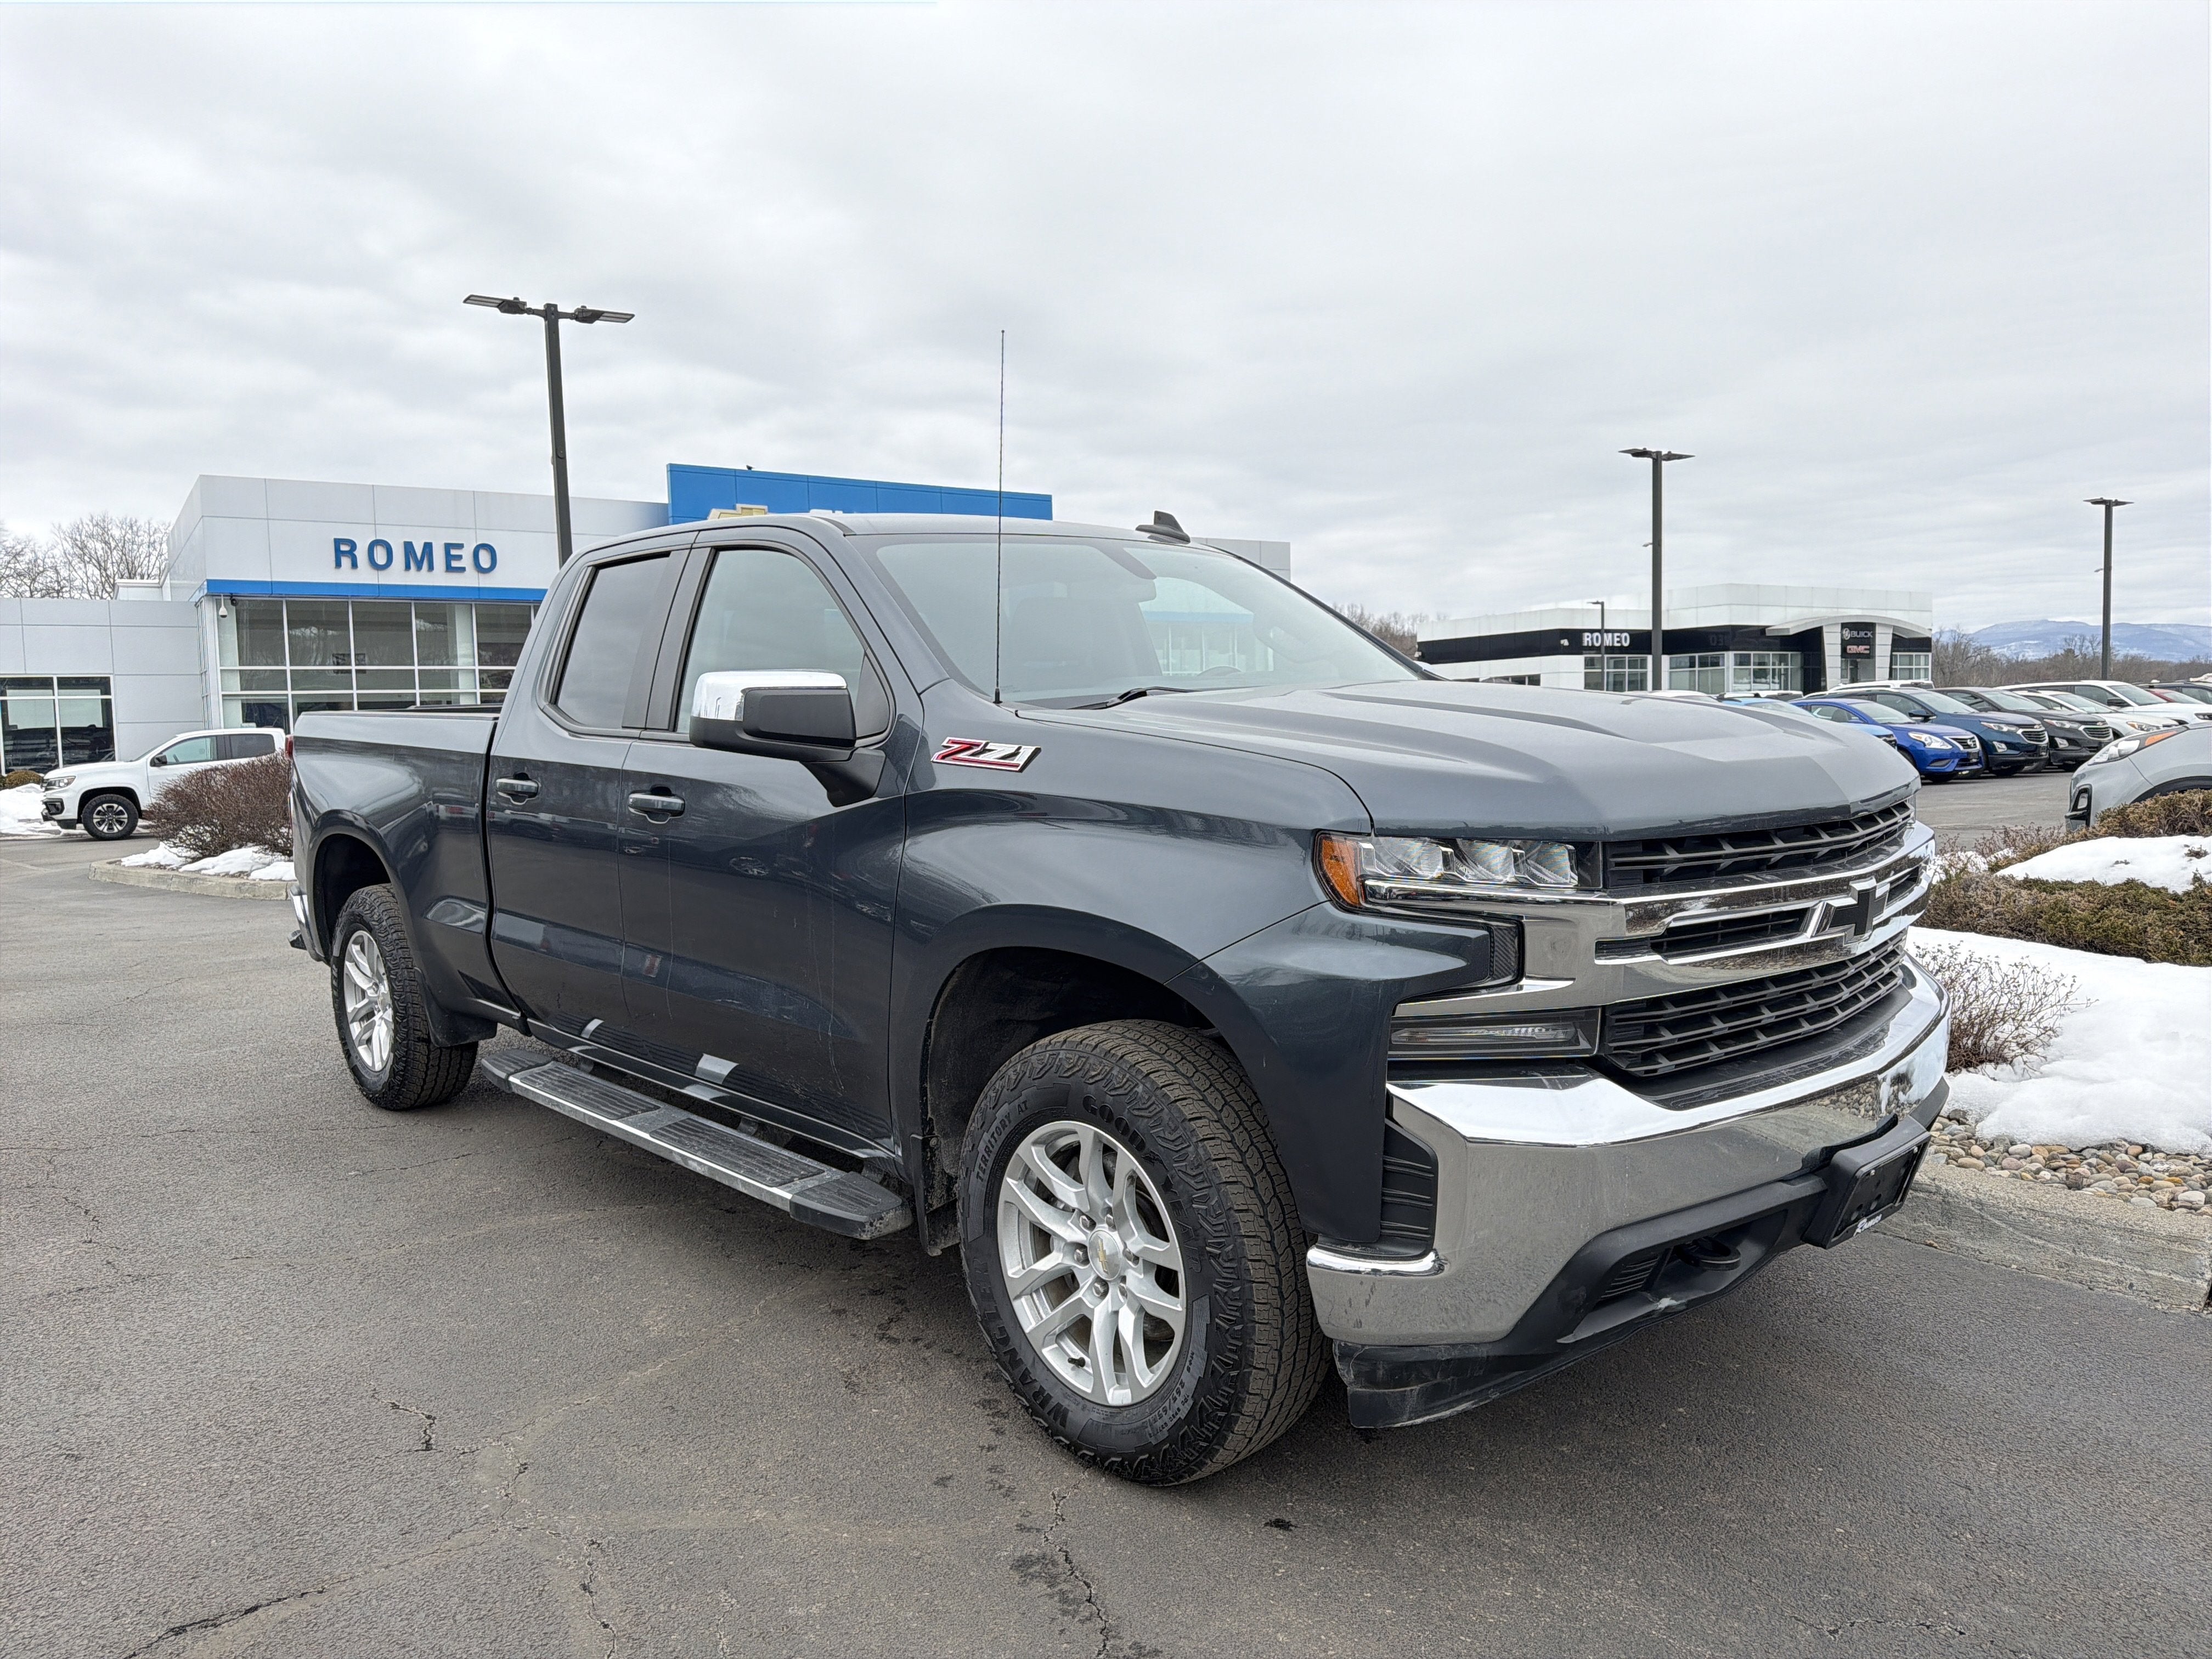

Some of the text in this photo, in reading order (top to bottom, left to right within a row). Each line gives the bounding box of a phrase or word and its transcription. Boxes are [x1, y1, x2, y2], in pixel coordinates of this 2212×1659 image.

[333, 538, 497, 574] ROMEO
[1583, 633, 1630, 646] ROMEO
[1847, 645, 1870, 653] GMC
[931, 737, 1041, 772] Z71
[976, 1100, 1028, 1182] TERRITORY AT
[973, 1259, 1070, 1428] WRANGLER
